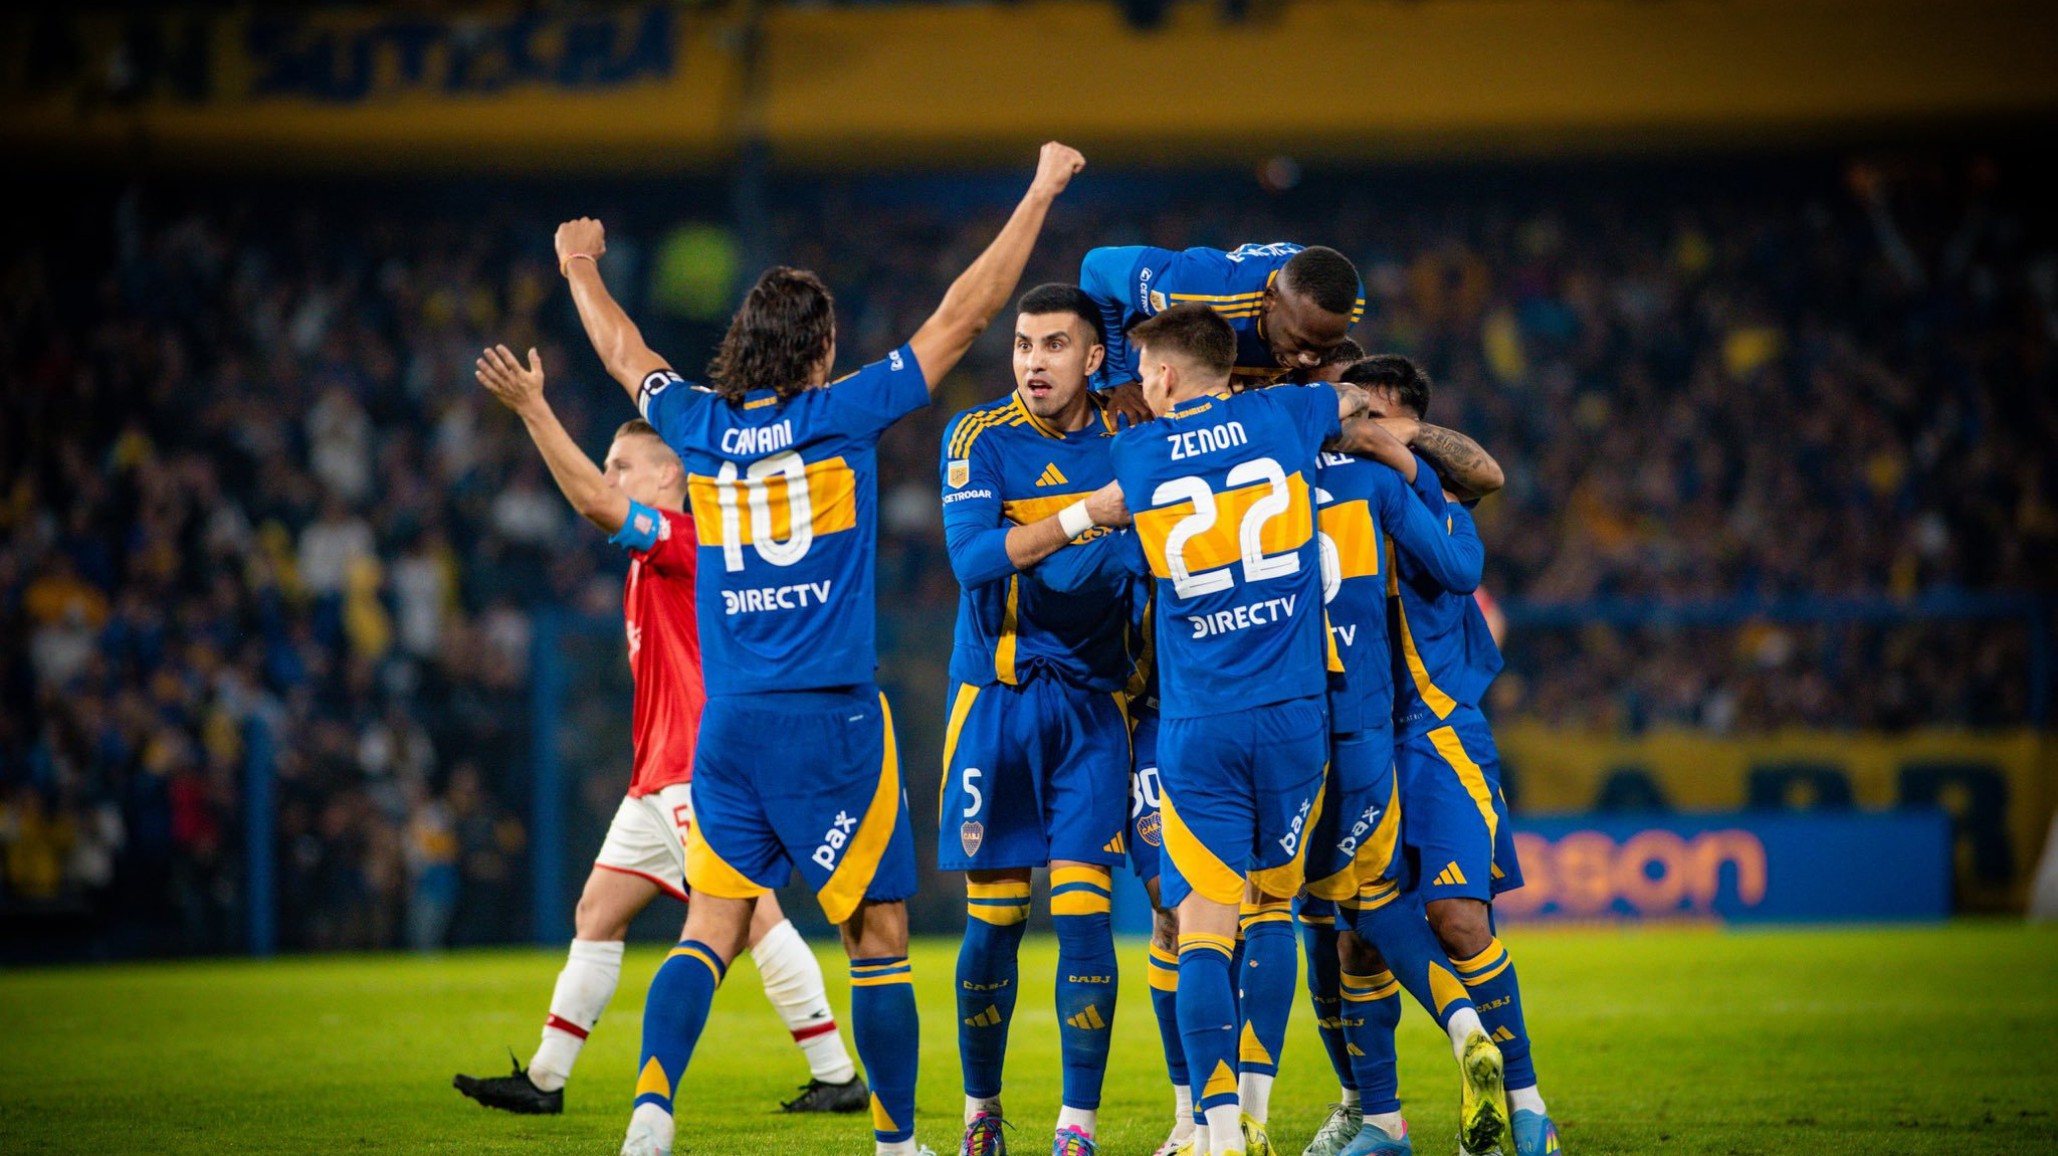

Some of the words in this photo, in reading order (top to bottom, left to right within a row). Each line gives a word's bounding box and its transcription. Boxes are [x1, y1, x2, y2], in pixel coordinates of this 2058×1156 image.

[721, 419, 793, 456] CAVANI
[1167, 421, 1248, 461] ZENON
[716, 450, 813, 573] 10
[1151, 457, 1300, 600] 22
[721, 580, 831, 615] DIRECTV
[1188, 594, 1296, 639] DIRECTV
[962, 767, 982, 818] 5
[811, 810, 857, 872] pax
[1278, 798, 1311, 857] pax
[1337, 805, 1380, 857] pax
[963, 979, 1009, 991] CABJ
[1069, 974, 1111, 984] CABJ
[1475, 995, 1511, 1014] CABJ
